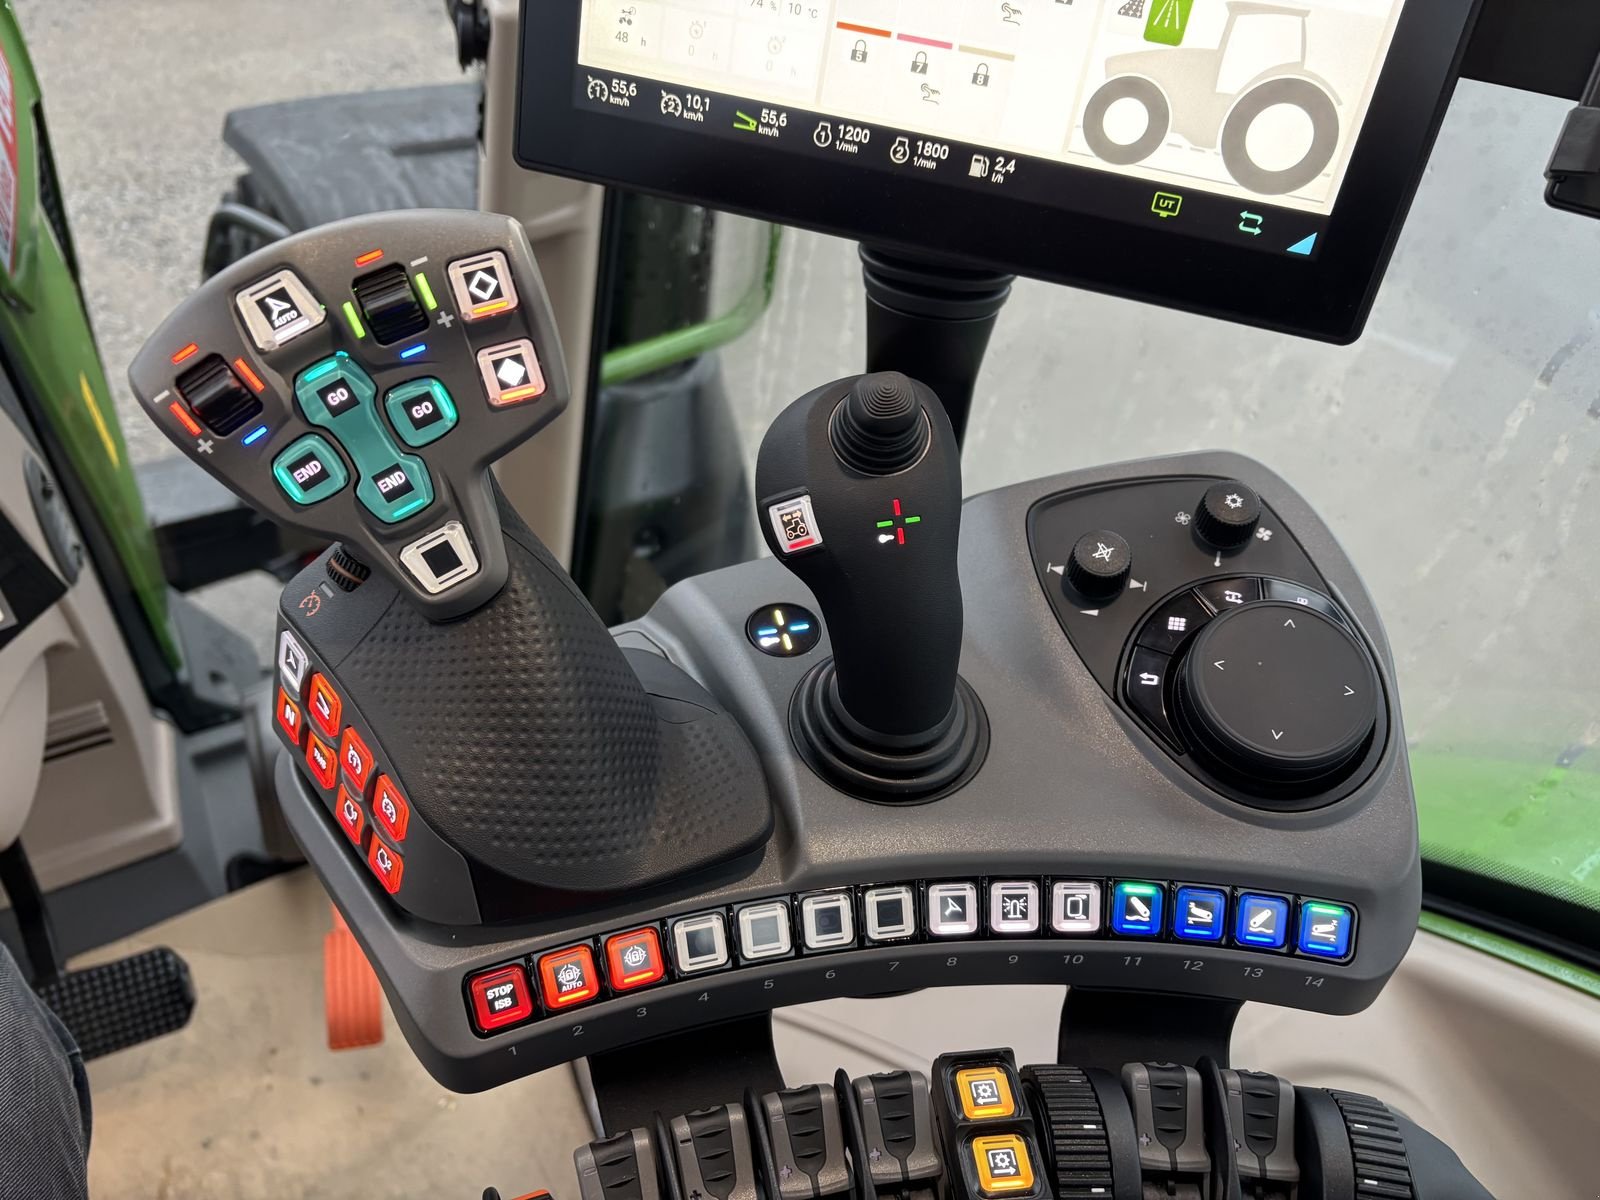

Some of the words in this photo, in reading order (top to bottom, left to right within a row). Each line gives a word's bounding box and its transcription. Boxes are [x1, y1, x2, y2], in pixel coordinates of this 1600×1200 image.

[788, 2, 802, 16] 10
[614, 31, 628, 43] 48
[640, 36, 646, 46] h
[856, 50, 862, 62] 5
[916, 62, 924, 73] 7
[976, 74, 984, 86] 8
[611, 79, 637, 96] 55,6
[610, 94, 630, 107] km/h
[686, 94, 710, 112] 10,1
[683, 109, 704, 122] km/h
[760, 108, 787, 127] 55,6
[758, 124, 779, 138] km/h
[838, 124, 870, 144] 1200
[835, 140, 858, 154] 1/min
[896, 146, 904, 159] 2
[916, 140, 950, 160] 1800
[913, 156, 936, 170] 1/min
[994, 156, 1016, 174] 2,4
[1160, 198, 1176, 209] UT
[274, 310, 298, 328] AUTO
[327, 387, 349, 406] GO
[412, 401, 433, 419] GO
[293, 460, 322, 484] END
[377, 470, 406, 494] END
[284, 704, 296, 726] N
[946, 956, 958, 966] 8
[1008, 955, 1019, 964] 9
[1063, 954, 1084, 964] 10
[1123, 956, 1142, 966] 11
[888, 962, 900, 972] 7
[1183, 960, 1204, 972] 12
[1243, 966, 1264, 978] 13
[825, 970, 836, 980] 6
[562, 980, 583, 993] AUTO
[764, 980, 774, 990] 5
[1304, 976, 1324, 988] 14
[486, 983, 514, 1000] STOP
[698, 992, 710, 1002] 4
[494, 998, 512, 1011] ISB
[636, 1007, 648, 1018] 3
[572, 1026, 584, 1036] 2
[508, 1046, 517, 1056] 1
